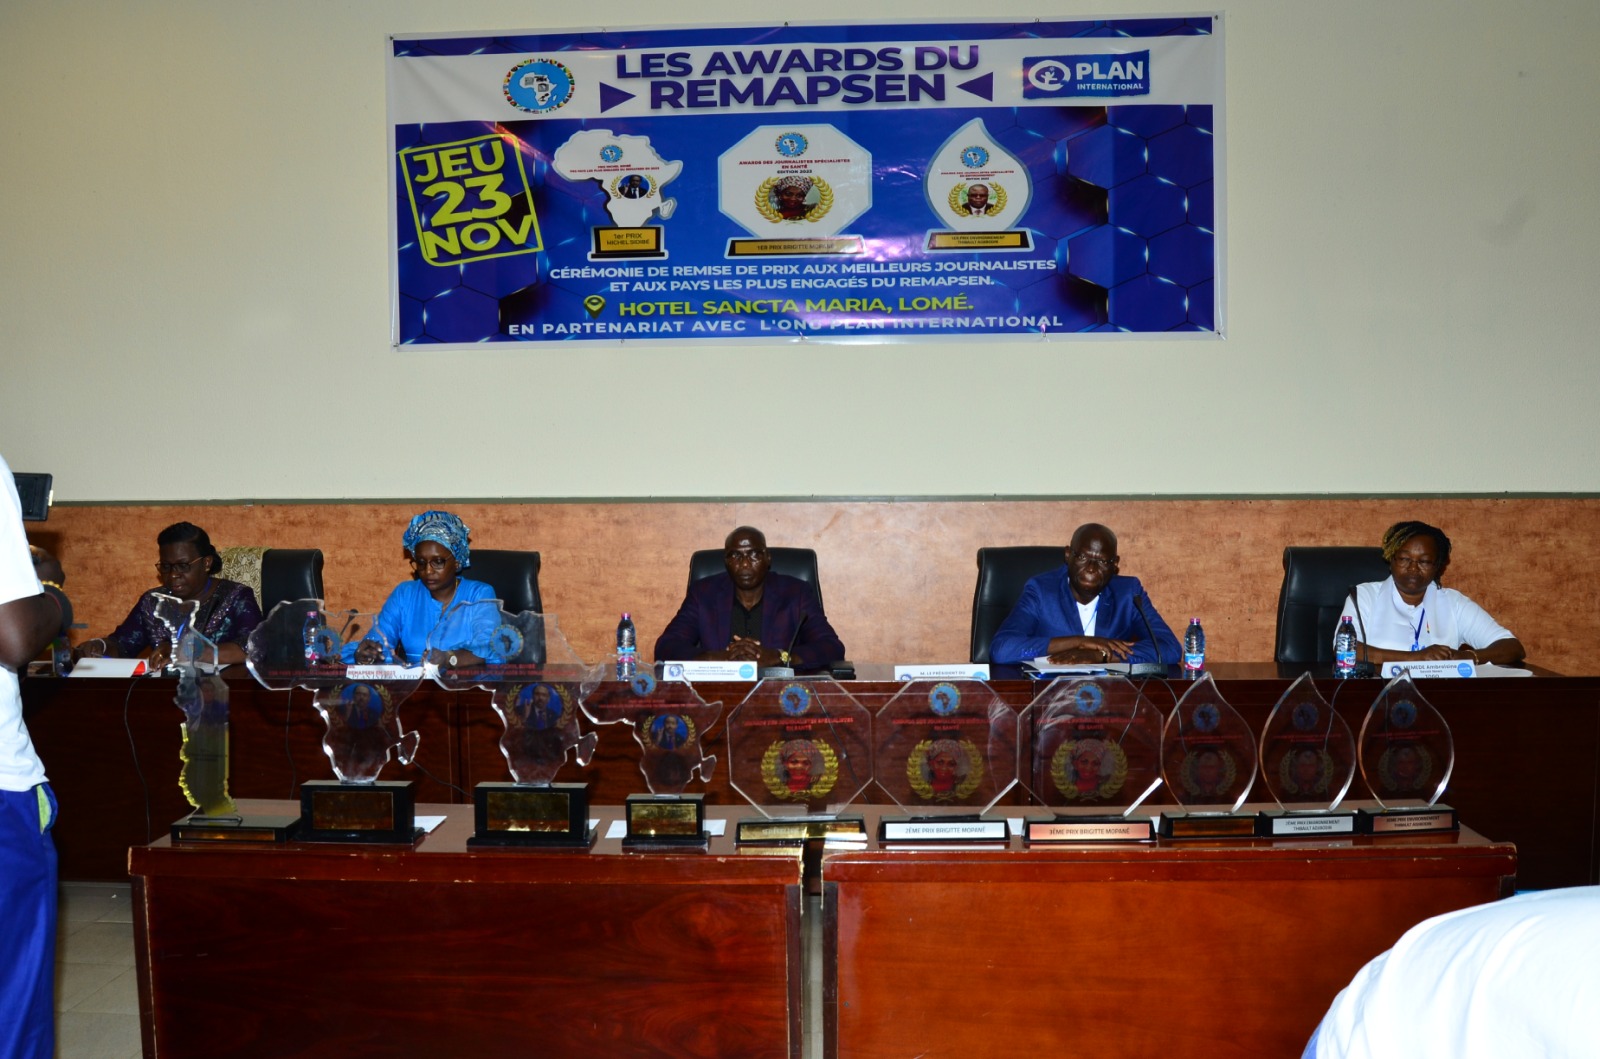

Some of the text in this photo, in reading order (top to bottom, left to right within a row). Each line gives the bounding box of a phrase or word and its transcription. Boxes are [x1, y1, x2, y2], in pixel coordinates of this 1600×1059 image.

[616, 44, 979, 78] LES AWARDS DU
[1077, 60, 1144, 81] PLAN
[650, 73, 947, 109] REMAPSEN
[1077, 83, 1144, 91] INTERNATIONAL
[413, 140, 505, 183] JEU
[421, 173, 513, 228] 23
[423, 214, 533, 259] NOV
[550, 260, 1057, 279] CÉRÉMONIE DE REMISE DE PRIX AUX MEILLEURS JOURNALISTES
[610, 276, 995, 292] ET AUX PAYS LES PLUS ENGAGÉS DU REMAPSEN.
[619, 293, 974, 316] HOTEL SANCTA MARIA, LOMÉ.
[508, 324, 534, 336] EN
[542, 321, 684, 334] PARTENARIAT
[691, 320, 746, 332] AVEC
[830, 317, 885, 330] PLAN
[893, 316, 1063, 329] INTERNATIONAL
